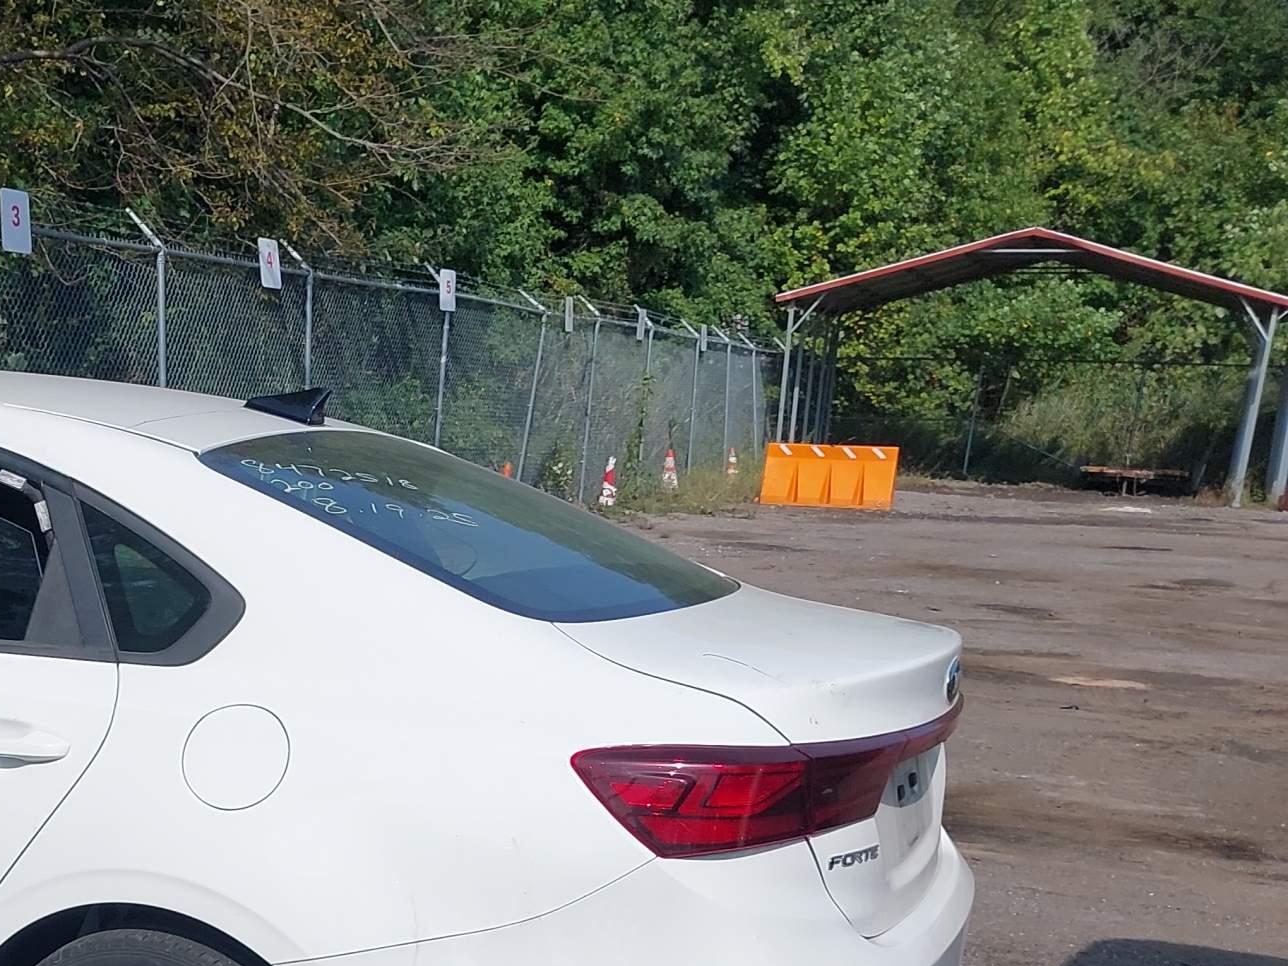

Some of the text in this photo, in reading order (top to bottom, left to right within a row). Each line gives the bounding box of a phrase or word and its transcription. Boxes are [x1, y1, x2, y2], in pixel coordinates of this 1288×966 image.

[11, 204, 21, 227] 3
[266, 251, 274, 268] 4
[446, 279, 452, 295] 5
[828, 844, 880, 870] FORTE
